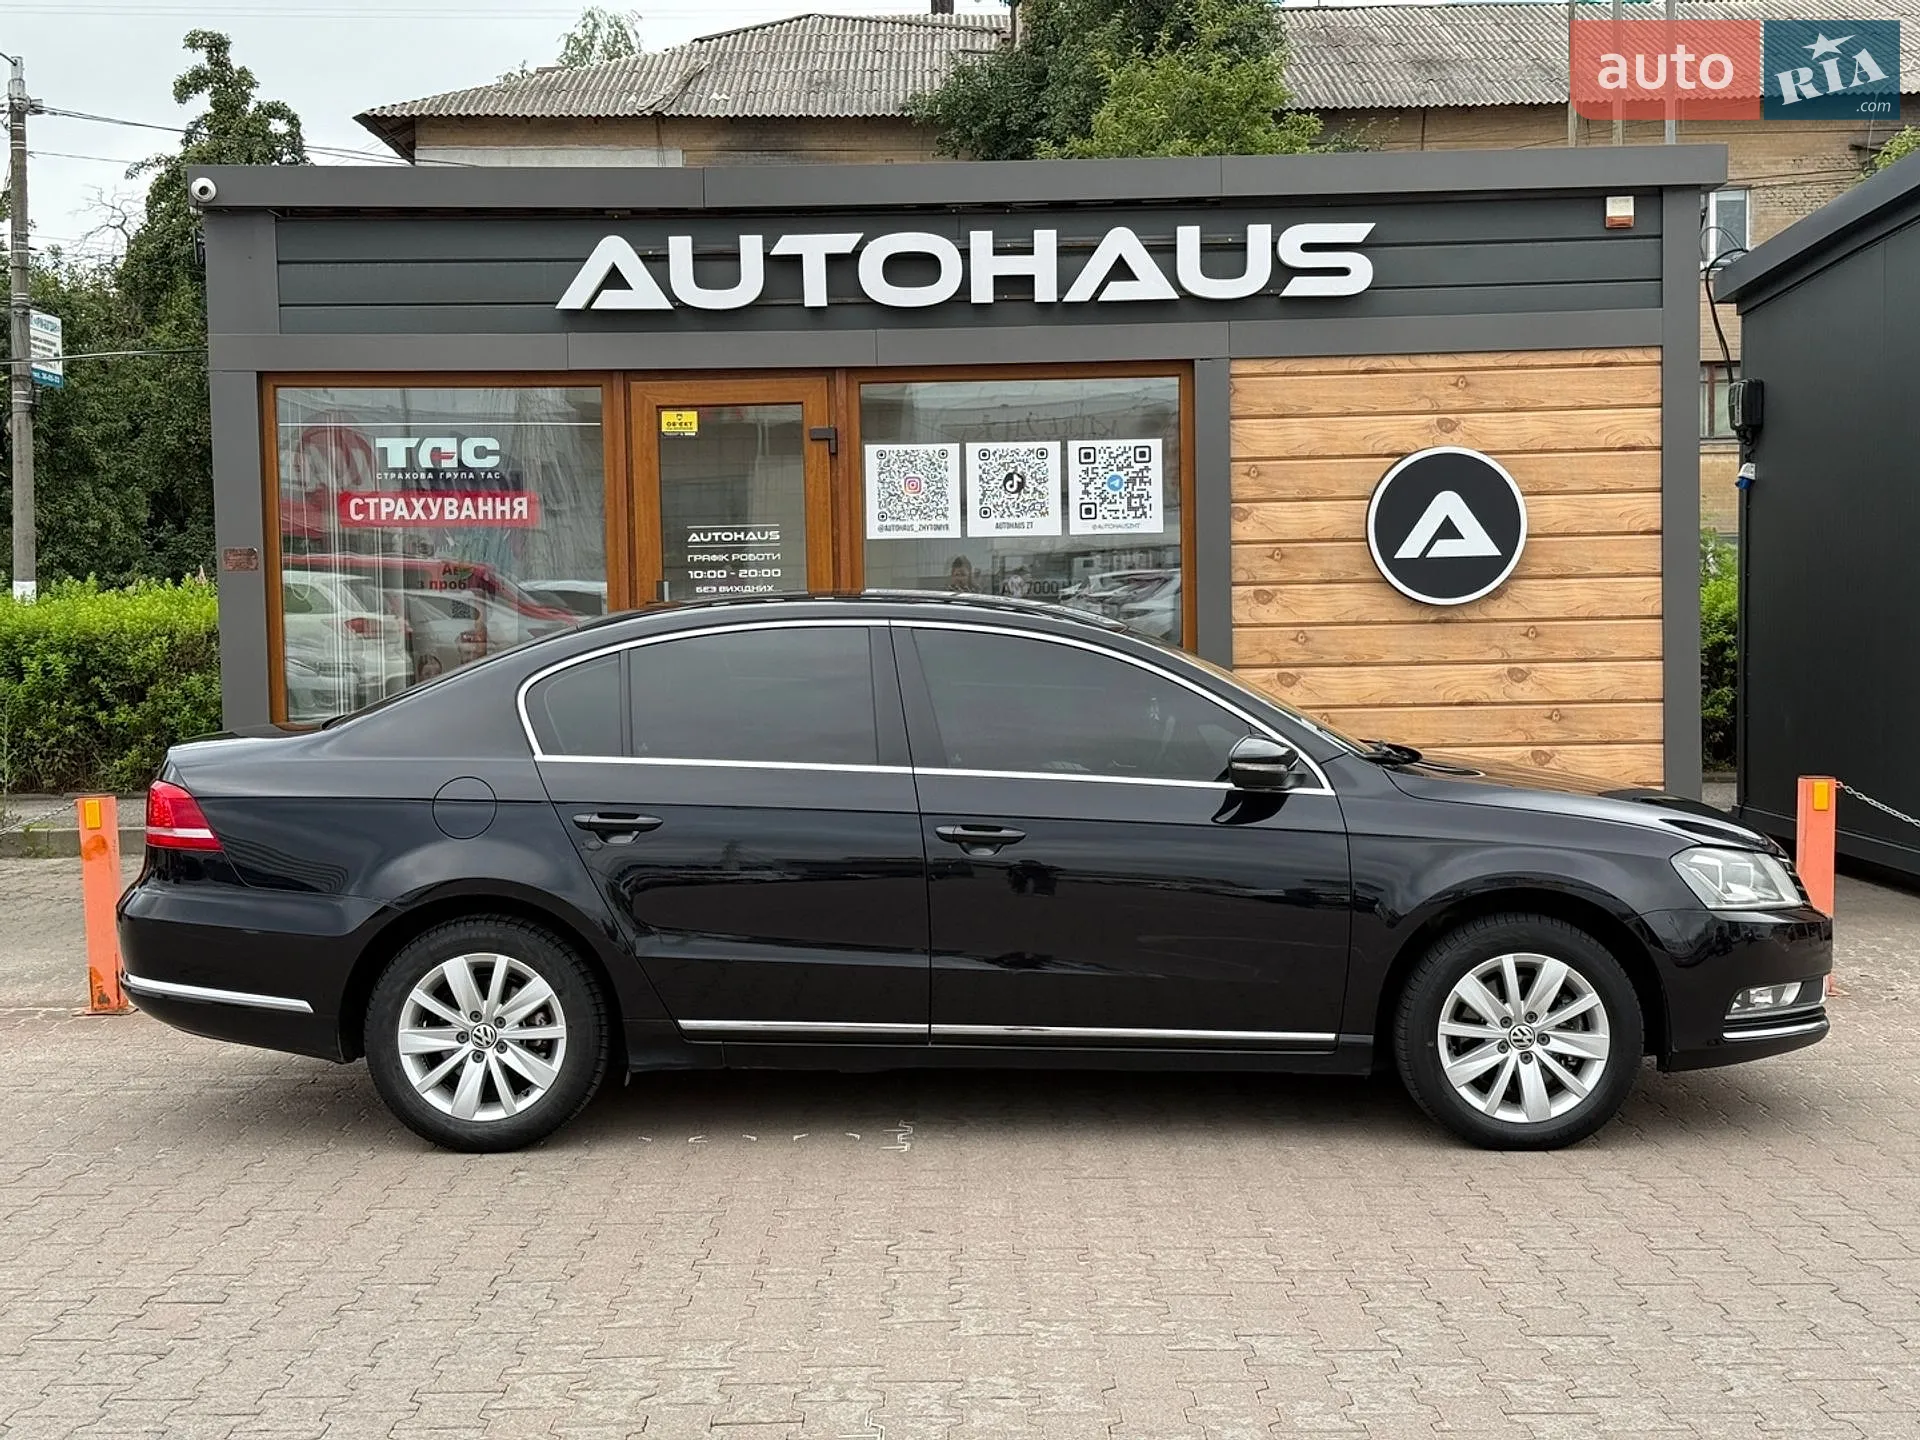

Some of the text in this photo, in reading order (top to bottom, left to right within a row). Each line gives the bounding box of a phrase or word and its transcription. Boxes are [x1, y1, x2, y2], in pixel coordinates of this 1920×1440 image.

[555, 222, 1377, 311] AUTOHAUS
[376, 472, 500, 481] СТРАХОВА ГРУПА ТАС
[349, 496, 528, 521] СТРАХУВАННЯ
[687, 530, 781, 543] AUTOHAUS
[687, 552, 782, 563] ГРАФІК РОБОТИ
[687, 569, 728, 580] 10:00
[738, 568, 782, 578] 20:00
